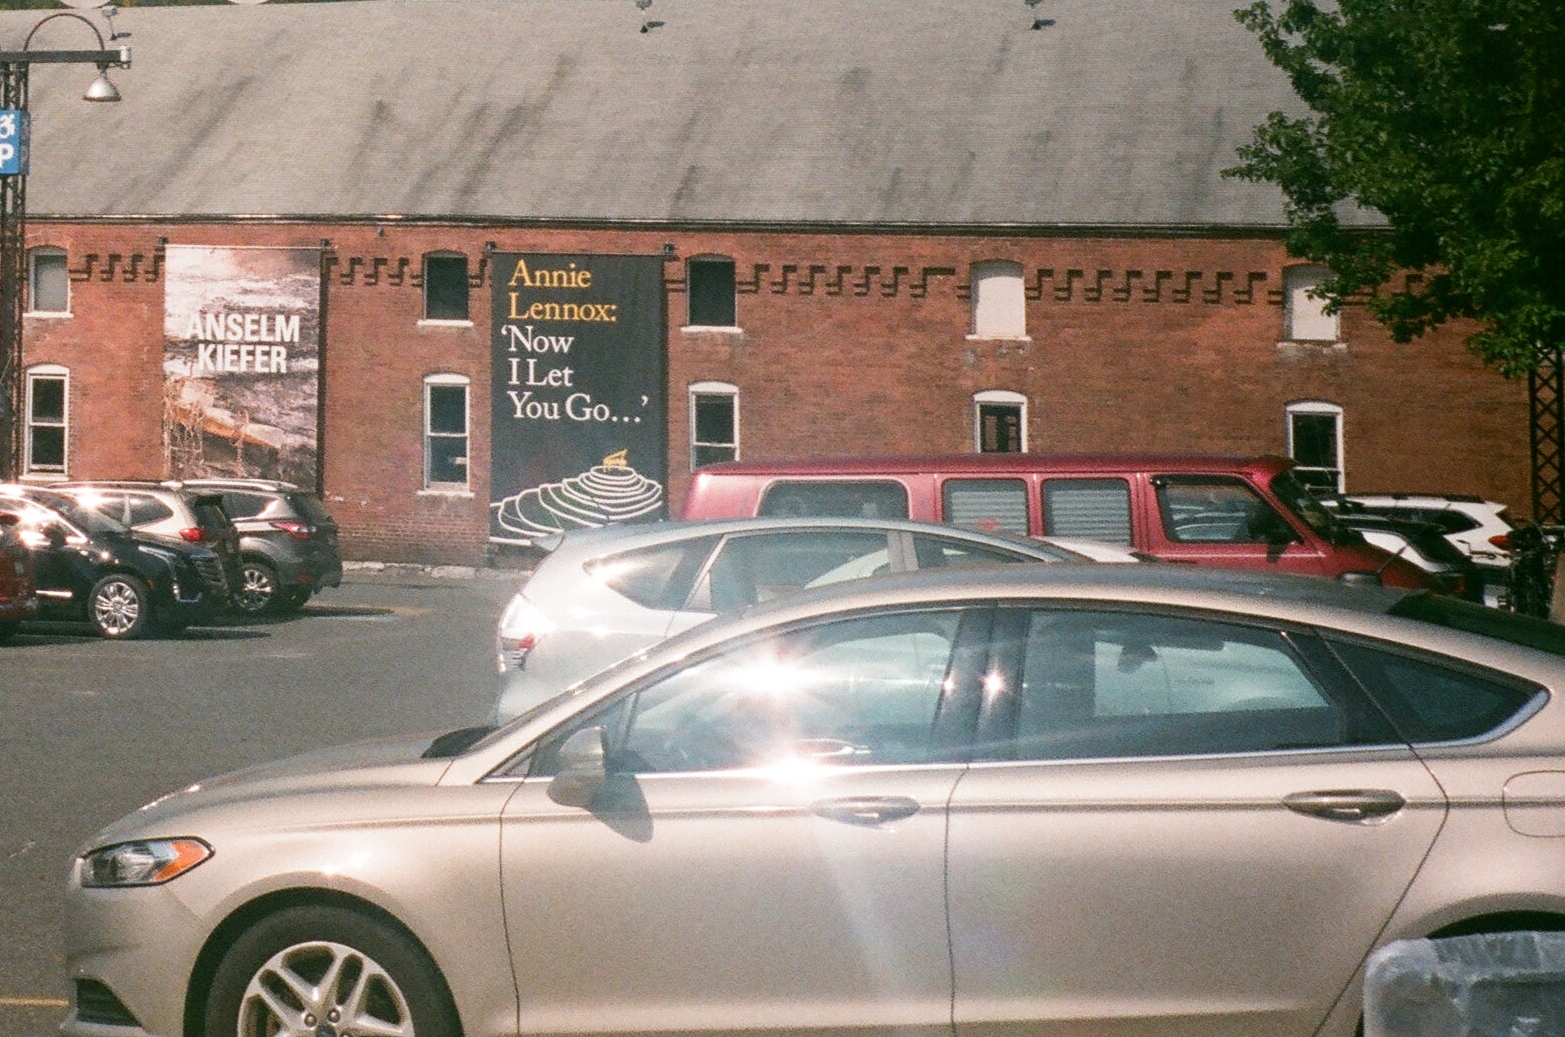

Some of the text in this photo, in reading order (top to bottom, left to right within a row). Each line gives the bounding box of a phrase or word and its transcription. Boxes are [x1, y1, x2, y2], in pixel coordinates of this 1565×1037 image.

[508, 258, 592, 287] Annie
[508, 292, 618, 322] Lennox:
[185, 313, 300, 342] ANSELM
[198, 344, 287, 373] KIEFER
[508, 358, 574, 386] I Let
[507, 391, 561, 420] You
